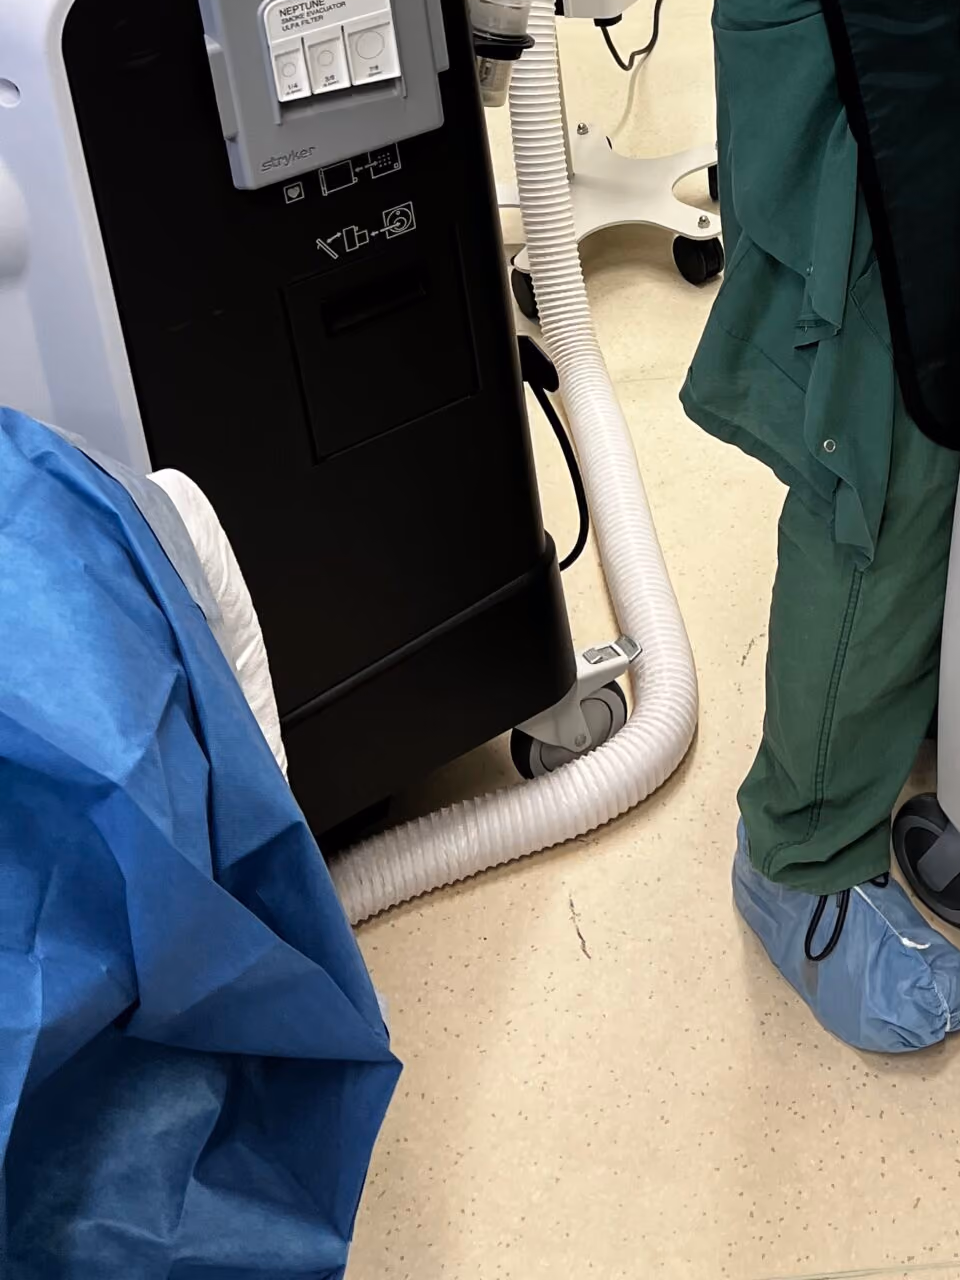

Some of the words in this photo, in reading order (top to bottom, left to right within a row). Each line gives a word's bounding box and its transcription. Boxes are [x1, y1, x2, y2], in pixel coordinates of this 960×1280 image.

[280, 12, 305, 26] SMOKE
[306, 0, 347, 18] EVACUATOR
[301, 14, 325, 27] FILTER
[260, 145, 317, 172] stryker
